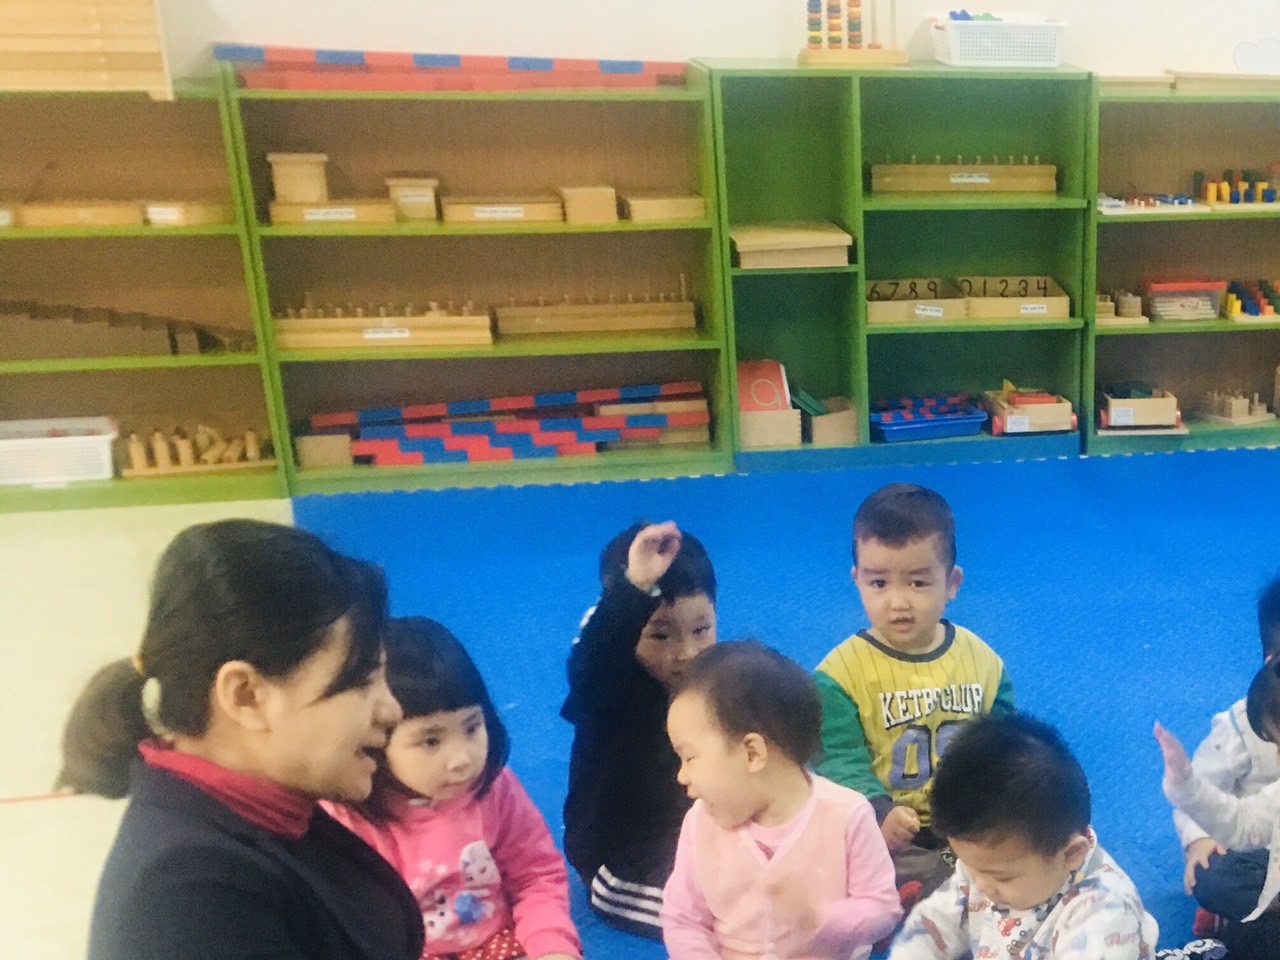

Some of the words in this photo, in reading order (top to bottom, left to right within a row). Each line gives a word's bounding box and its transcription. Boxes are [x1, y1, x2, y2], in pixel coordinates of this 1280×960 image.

[999, 278, 1010, 298] 2
[1018, 278, 1029, 298] 3
[1036, 278, 1049, 299] 4
